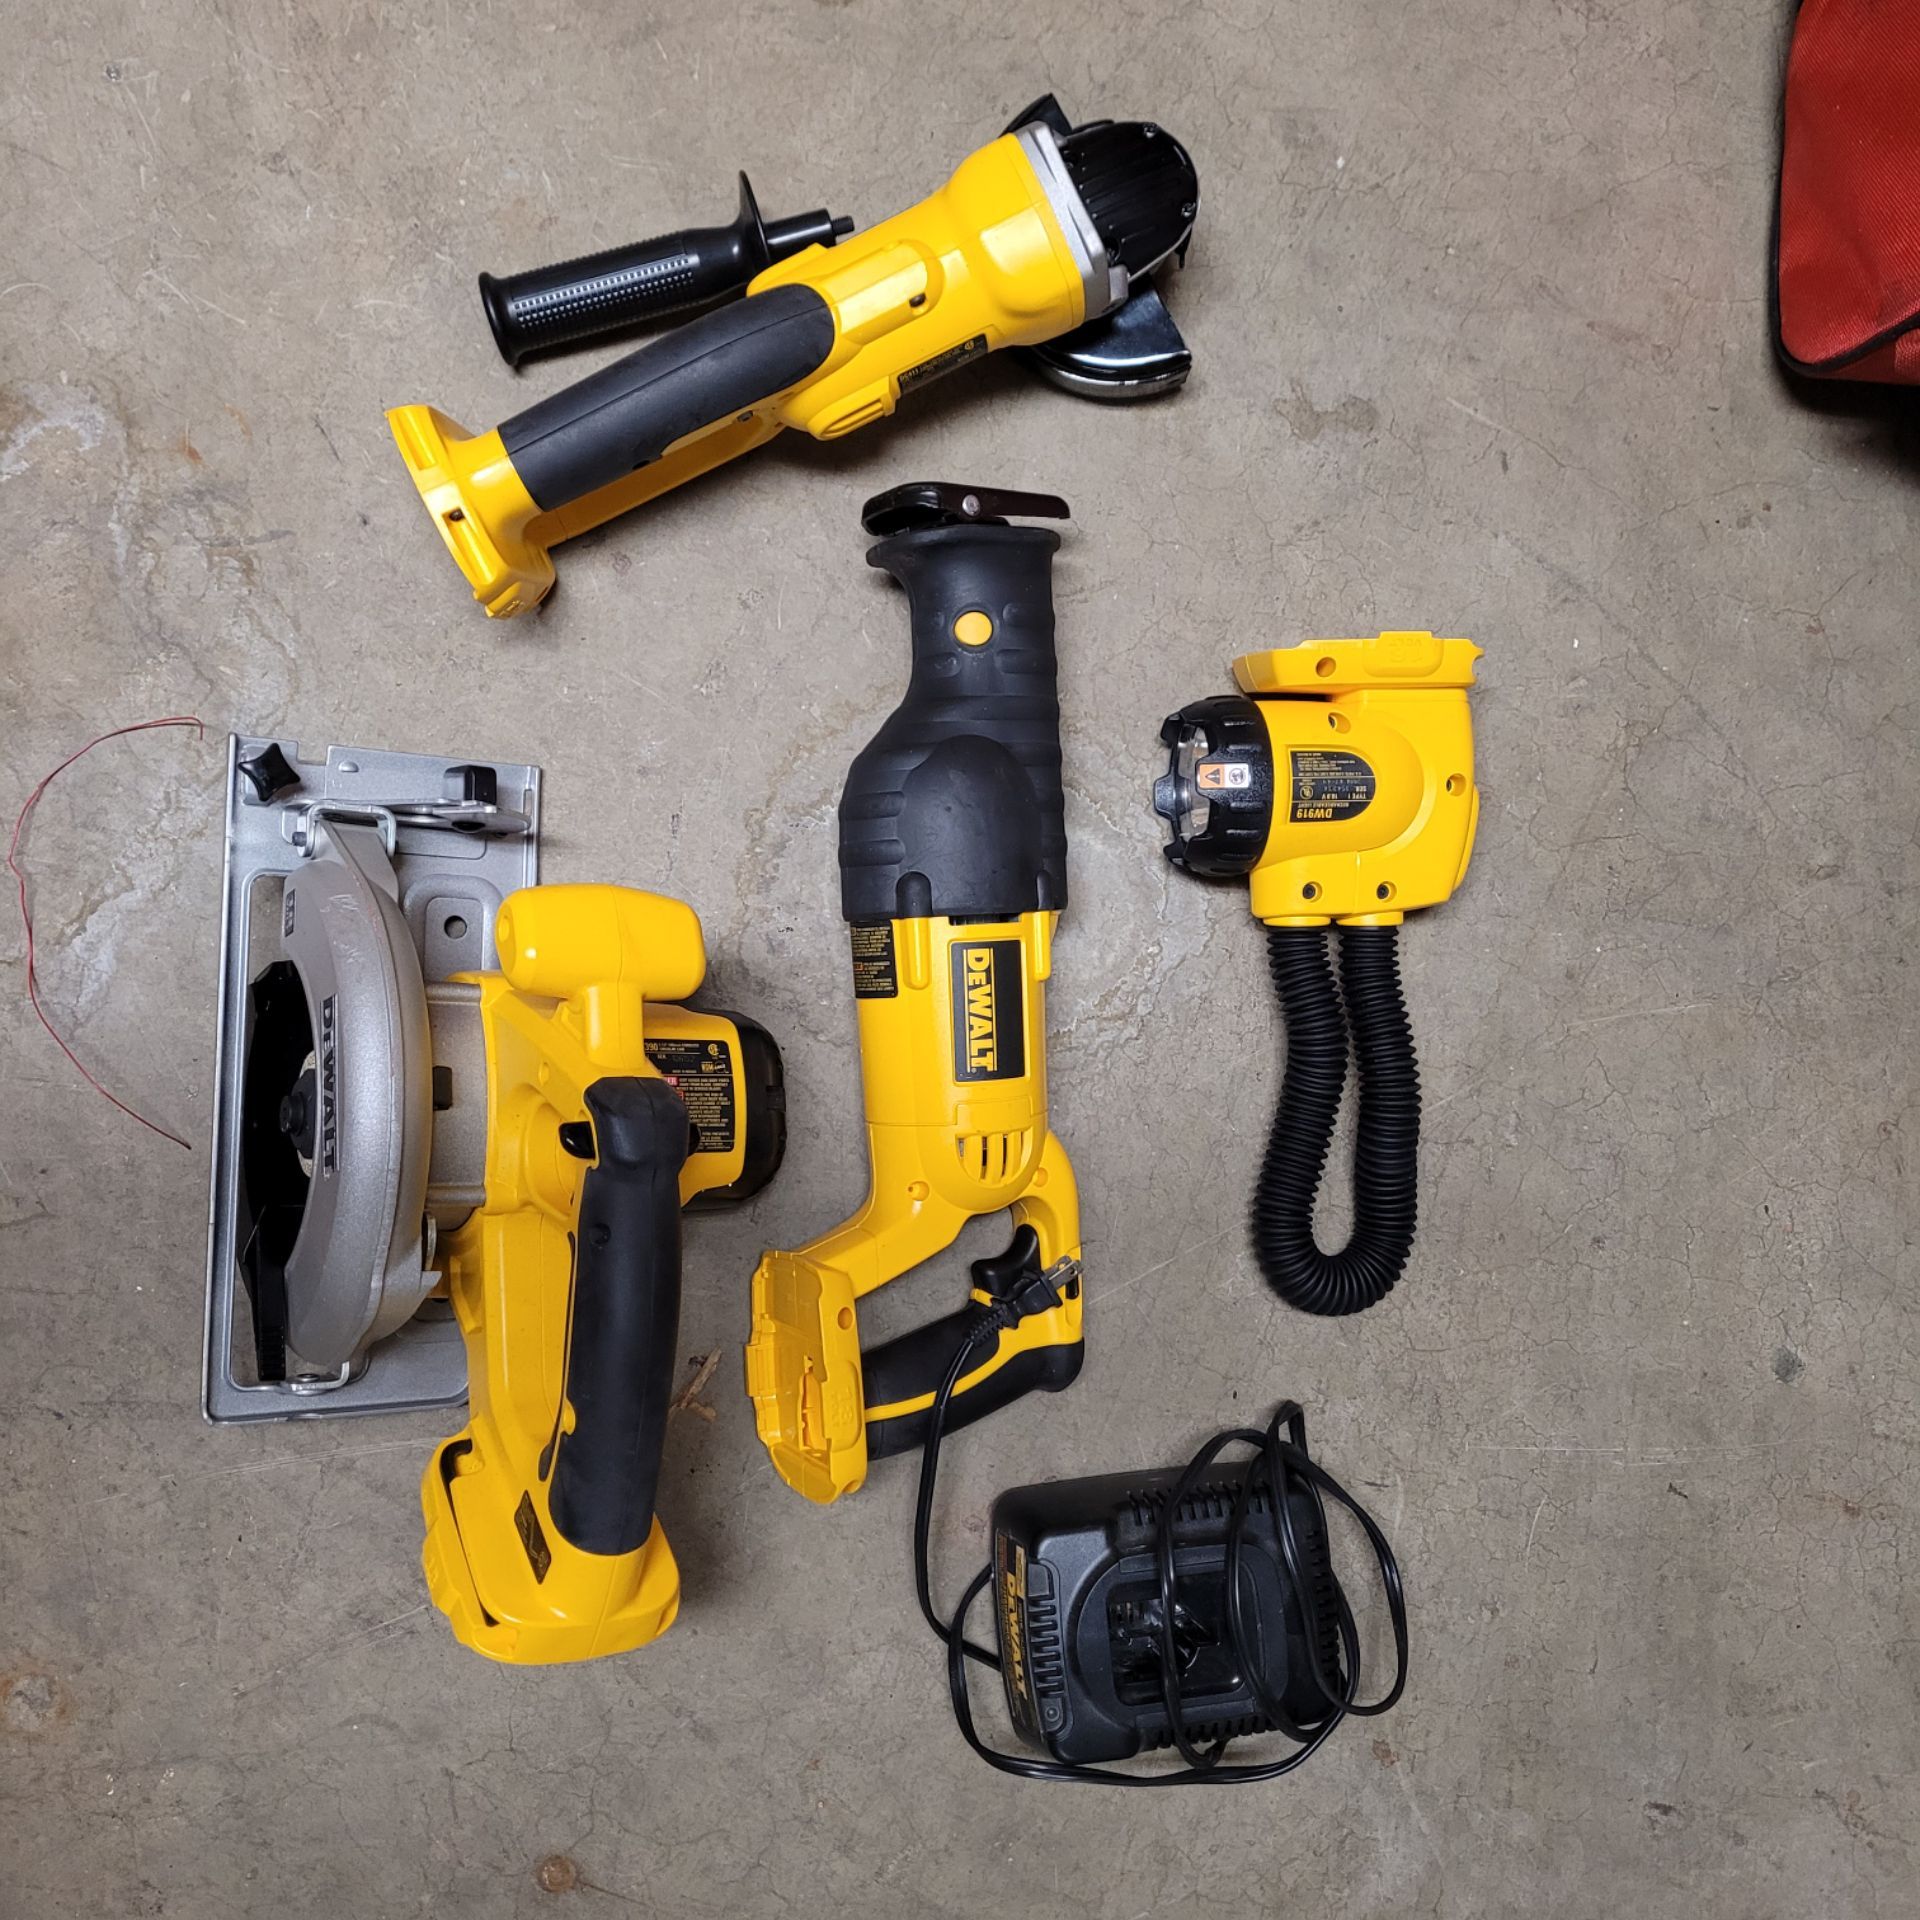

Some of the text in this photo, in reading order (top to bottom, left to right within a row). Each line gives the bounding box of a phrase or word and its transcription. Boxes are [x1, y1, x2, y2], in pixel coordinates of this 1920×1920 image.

[1296, 808, 1333, 819] DW919
[967, 948, 995, 1072] DEWALT
[322, 996, 337, 1172] DEWALT
[1007, 1571, 1028, 1700] DEWALT
